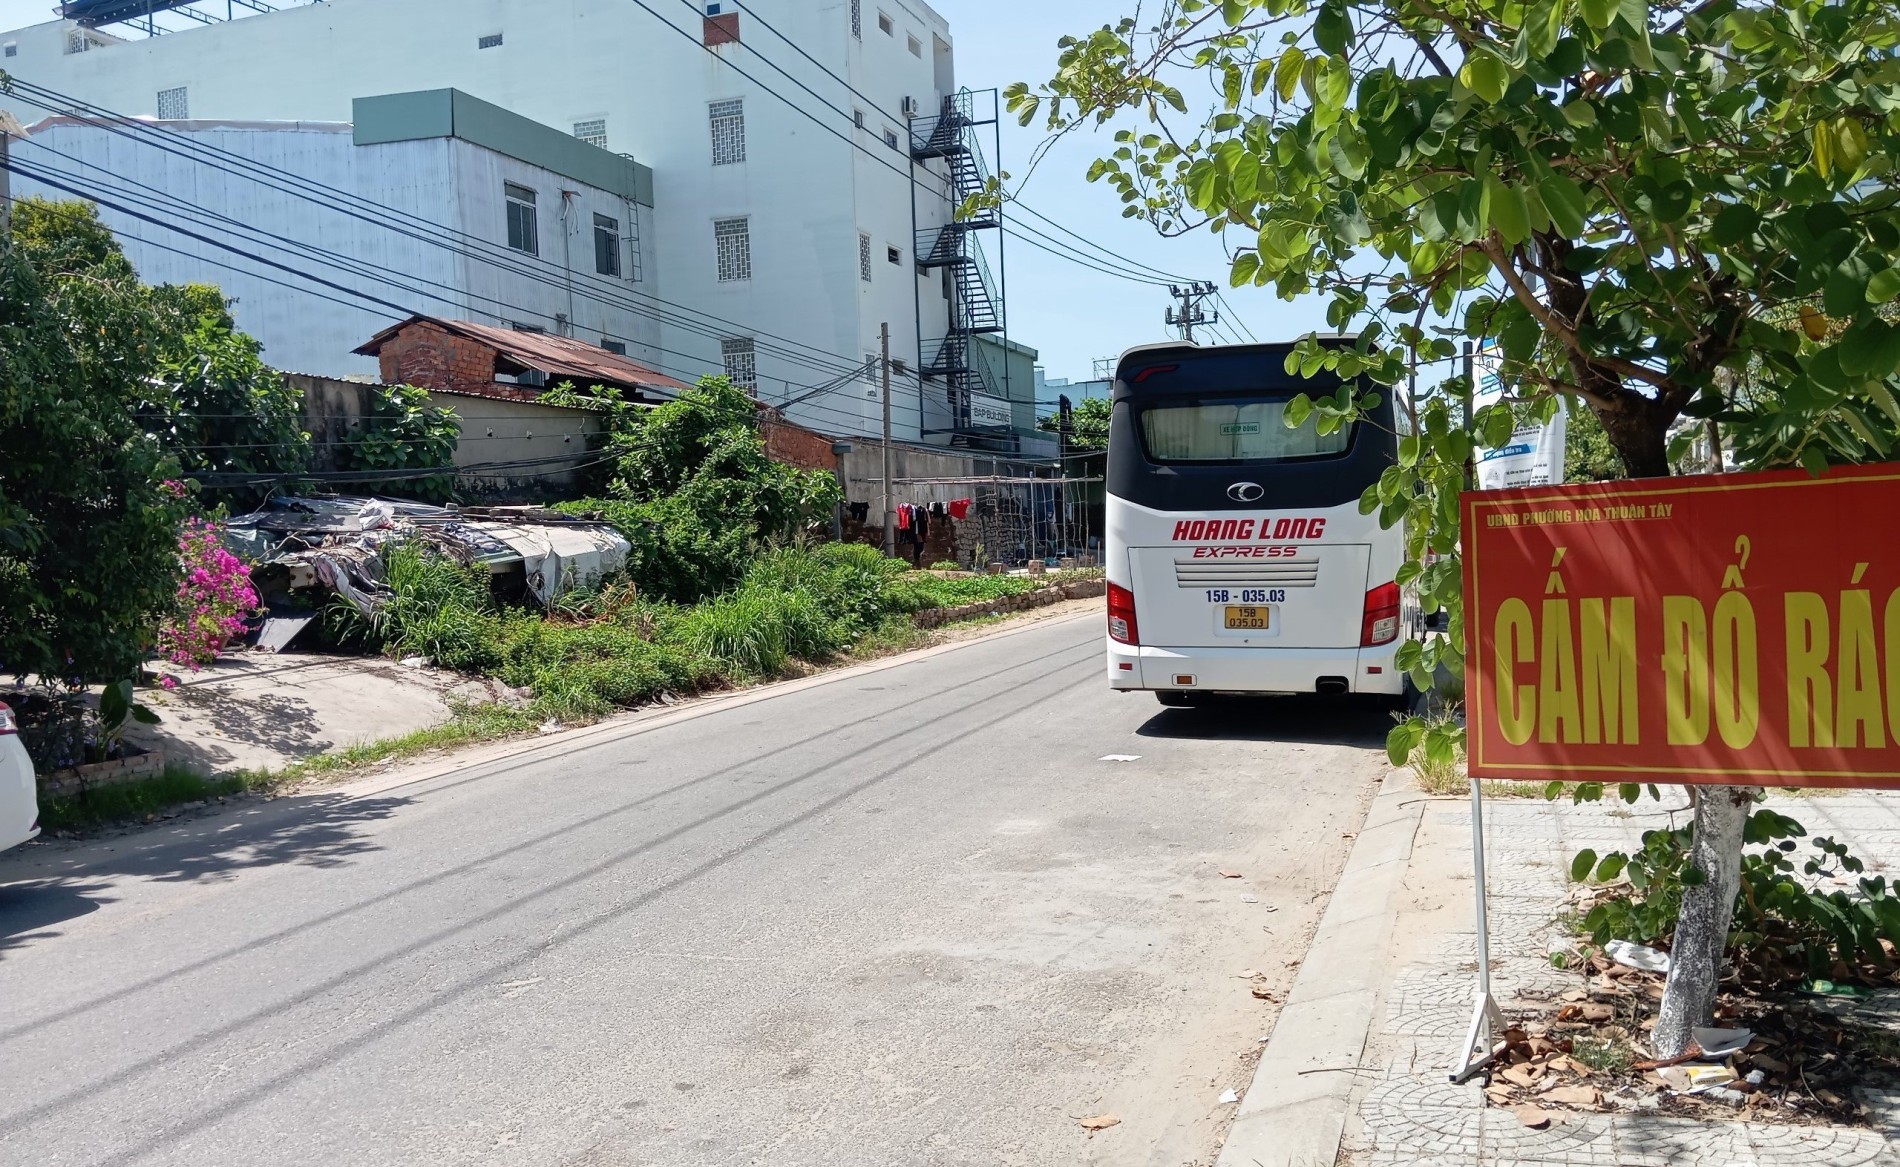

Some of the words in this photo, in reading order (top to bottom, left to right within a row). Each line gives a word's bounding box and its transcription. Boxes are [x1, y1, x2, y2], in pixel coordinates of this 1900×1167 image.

[1487, 513, 1519, 528] UBND
[1523, 508, 1572, 525] PHƯỜNG
[1604, 503, 1646, 520] THUẬN
[1649, 502, 1673, 518] TÂY
[1172, 519, 1255, 541] HOANG
[1258, 518, 1326, 539] LONG
[1193, 546, 1298, 558] EXPRESS
[1206, 590, 1229, 603] 15B
[1242, 589, 1286, 603] 035.03
[1239, 608, 1256, 617] 15B
[1229, 618, 1264, 627] 035.03
[1494, 546, 1640, 746] CẤM
[1660, 534, 1760, 750] ĐỔ
